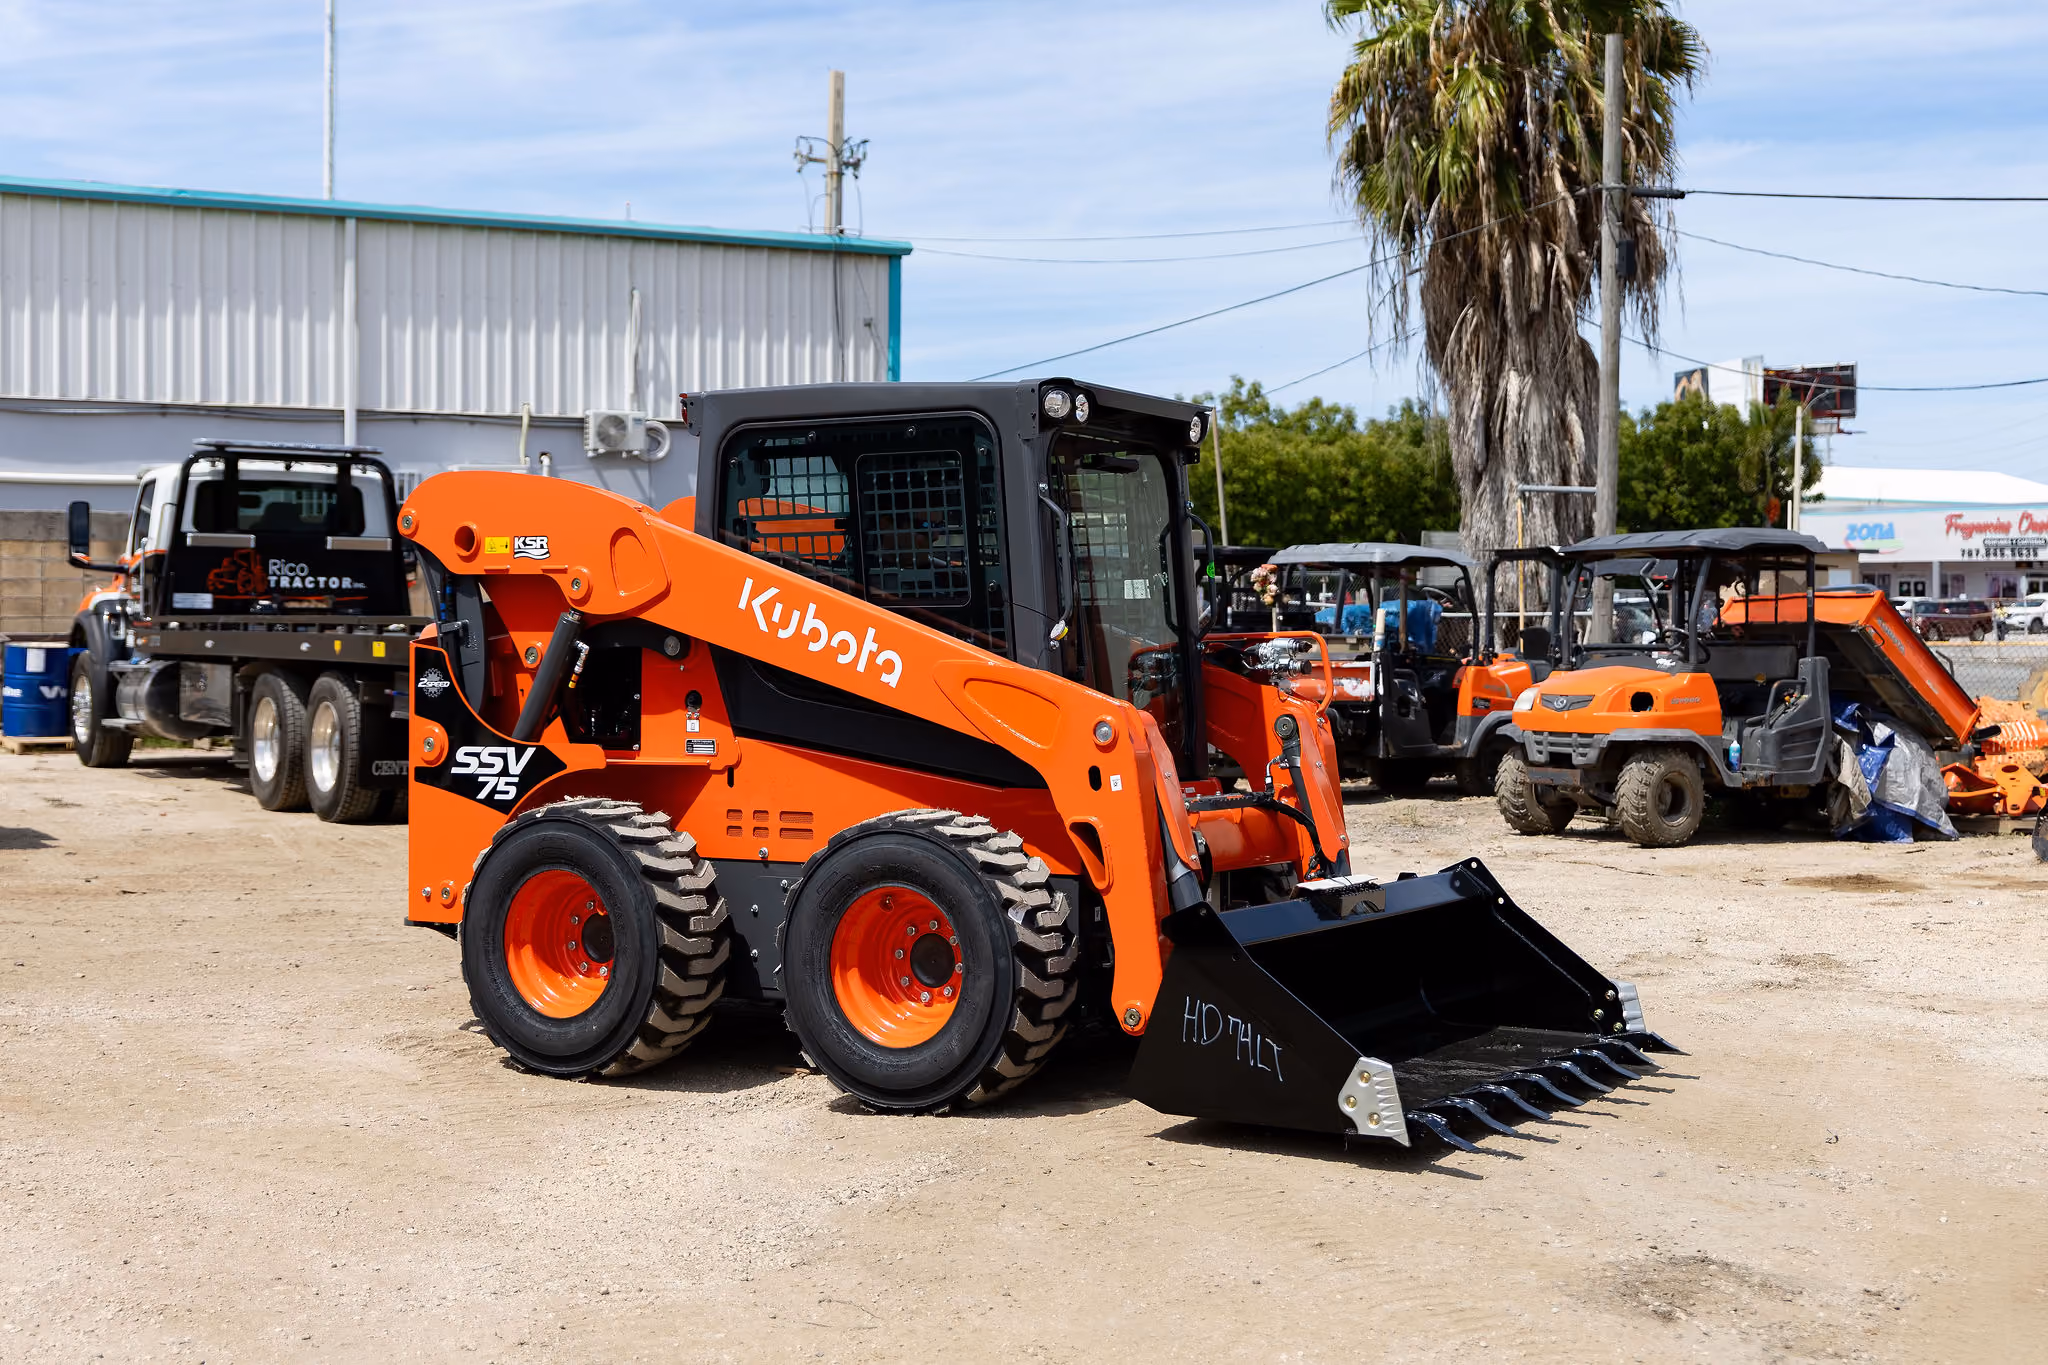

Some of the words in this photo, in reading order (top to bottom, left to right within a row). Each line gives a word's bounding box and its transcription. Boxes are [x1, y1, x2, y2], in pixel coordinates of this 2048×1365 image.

[514, 536, 548, 549] KSR
[268, 559, 309, 577] Rico
[267, 576, 352, 589] TRACTOR
[738, 577, 903, 689] Kubota
[371, 760, 409, 776] CENT
[450, 746, 537, 775] SSV
[476, 776, 519, 800] 75
[1182, 996, 1224, 1045] HD
